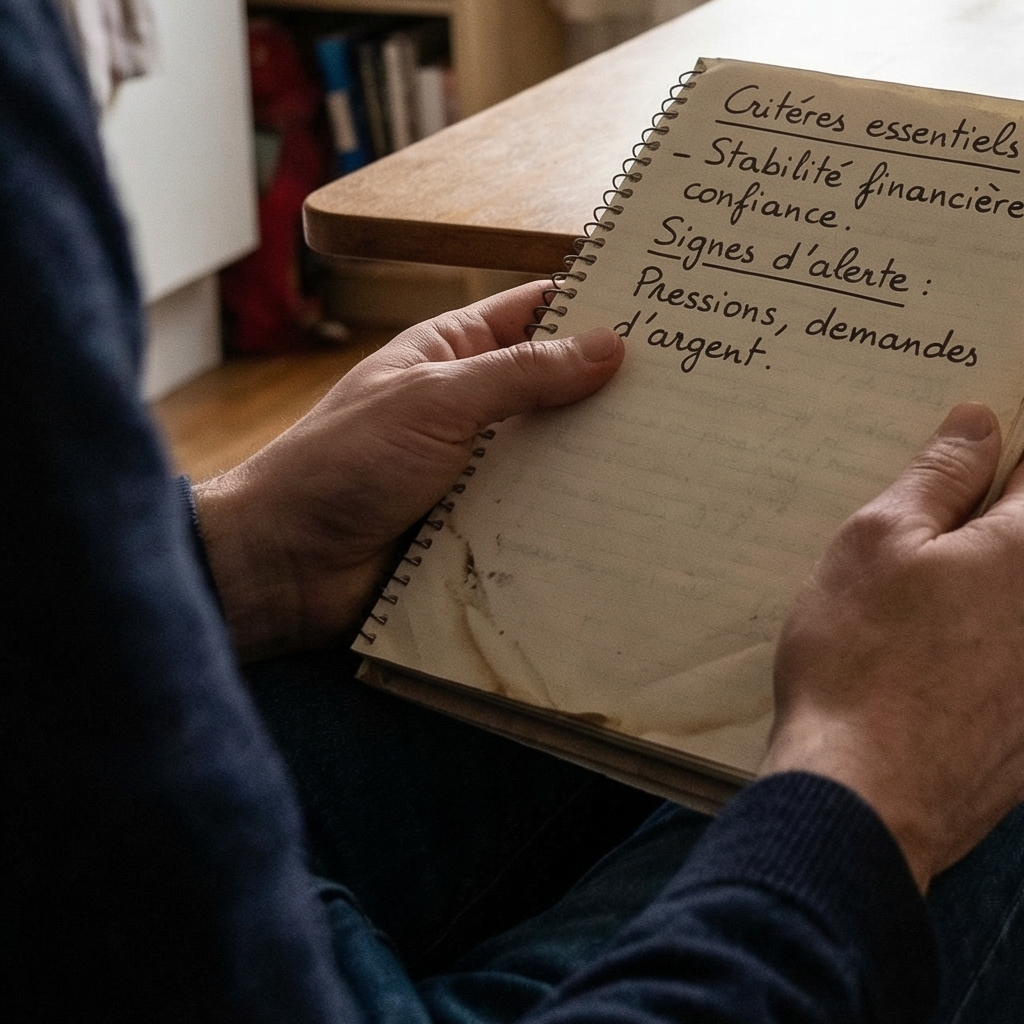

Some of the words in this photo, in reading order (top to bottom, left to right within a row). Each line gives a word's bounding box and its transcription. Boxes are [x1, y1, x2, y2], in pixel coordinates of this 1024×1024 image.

[704, 136, 854, 188] Stabilité
[683, 181, 851, 232] confiance.
[653, 215, 755, 271] Signes
[612, 310, 771, 374] d'argent.
[632, 265, 788, 337] Pressions,
[804, 306, 978, 368] demandes
